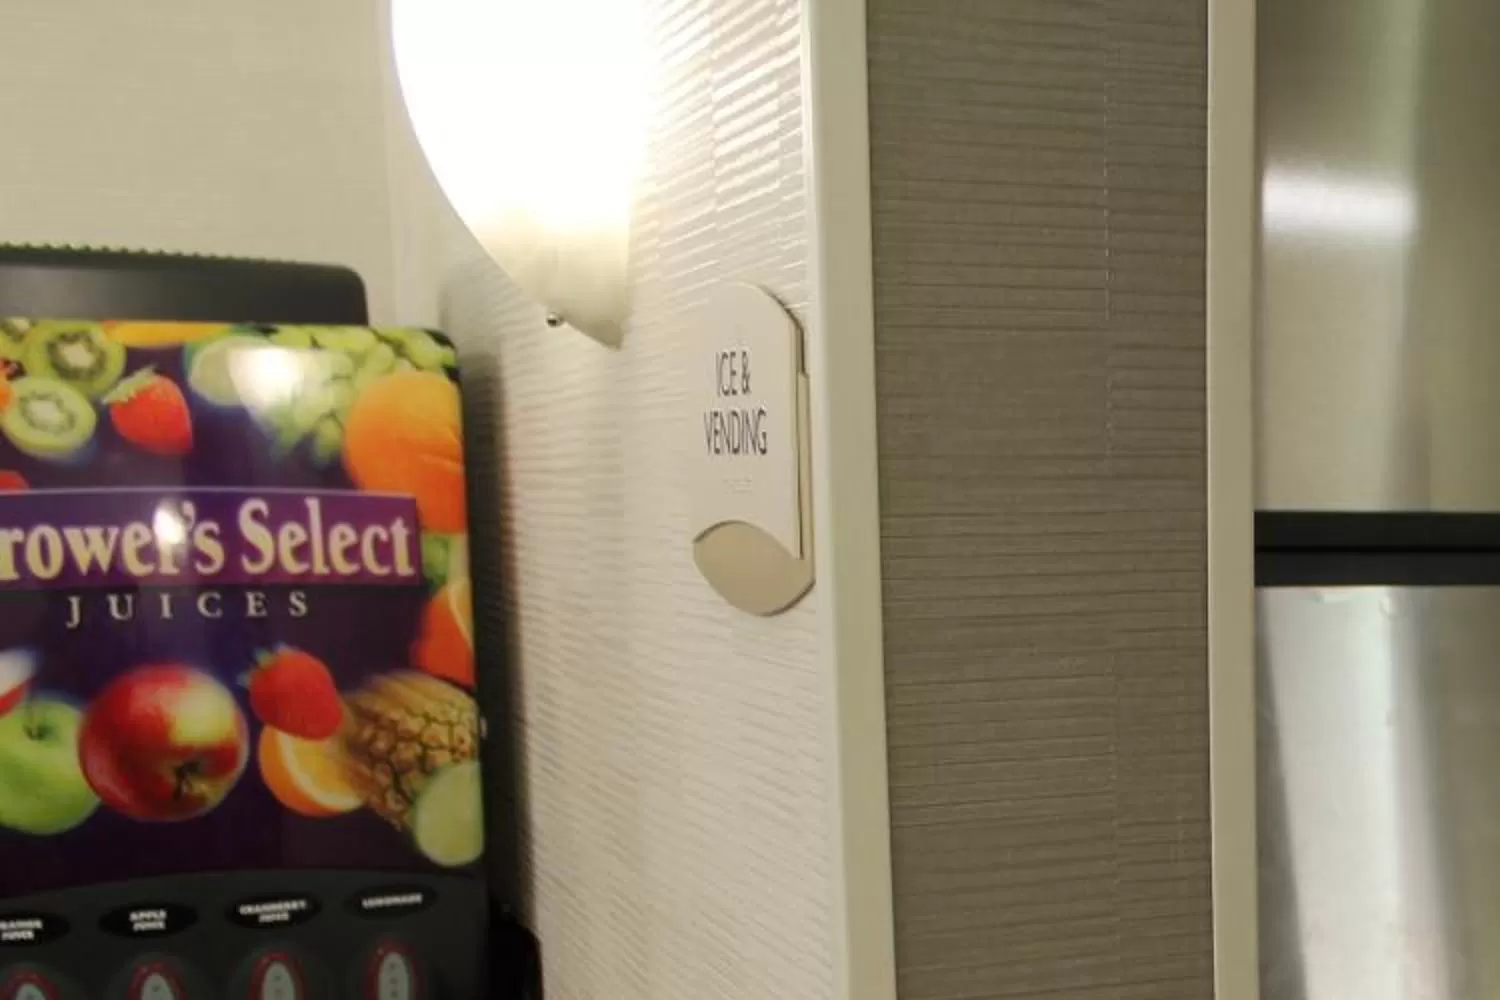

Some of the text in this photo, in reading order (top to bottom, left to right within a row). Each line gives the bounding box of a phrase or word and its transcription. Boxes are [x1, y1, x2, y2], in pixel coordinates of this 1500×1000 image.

[715, 351, 752, 397] ICE &
[703, 408, 768, 456] VENDING
[237, 496, 417, 577] Select
[66, 591, 308, 629] JUICES
